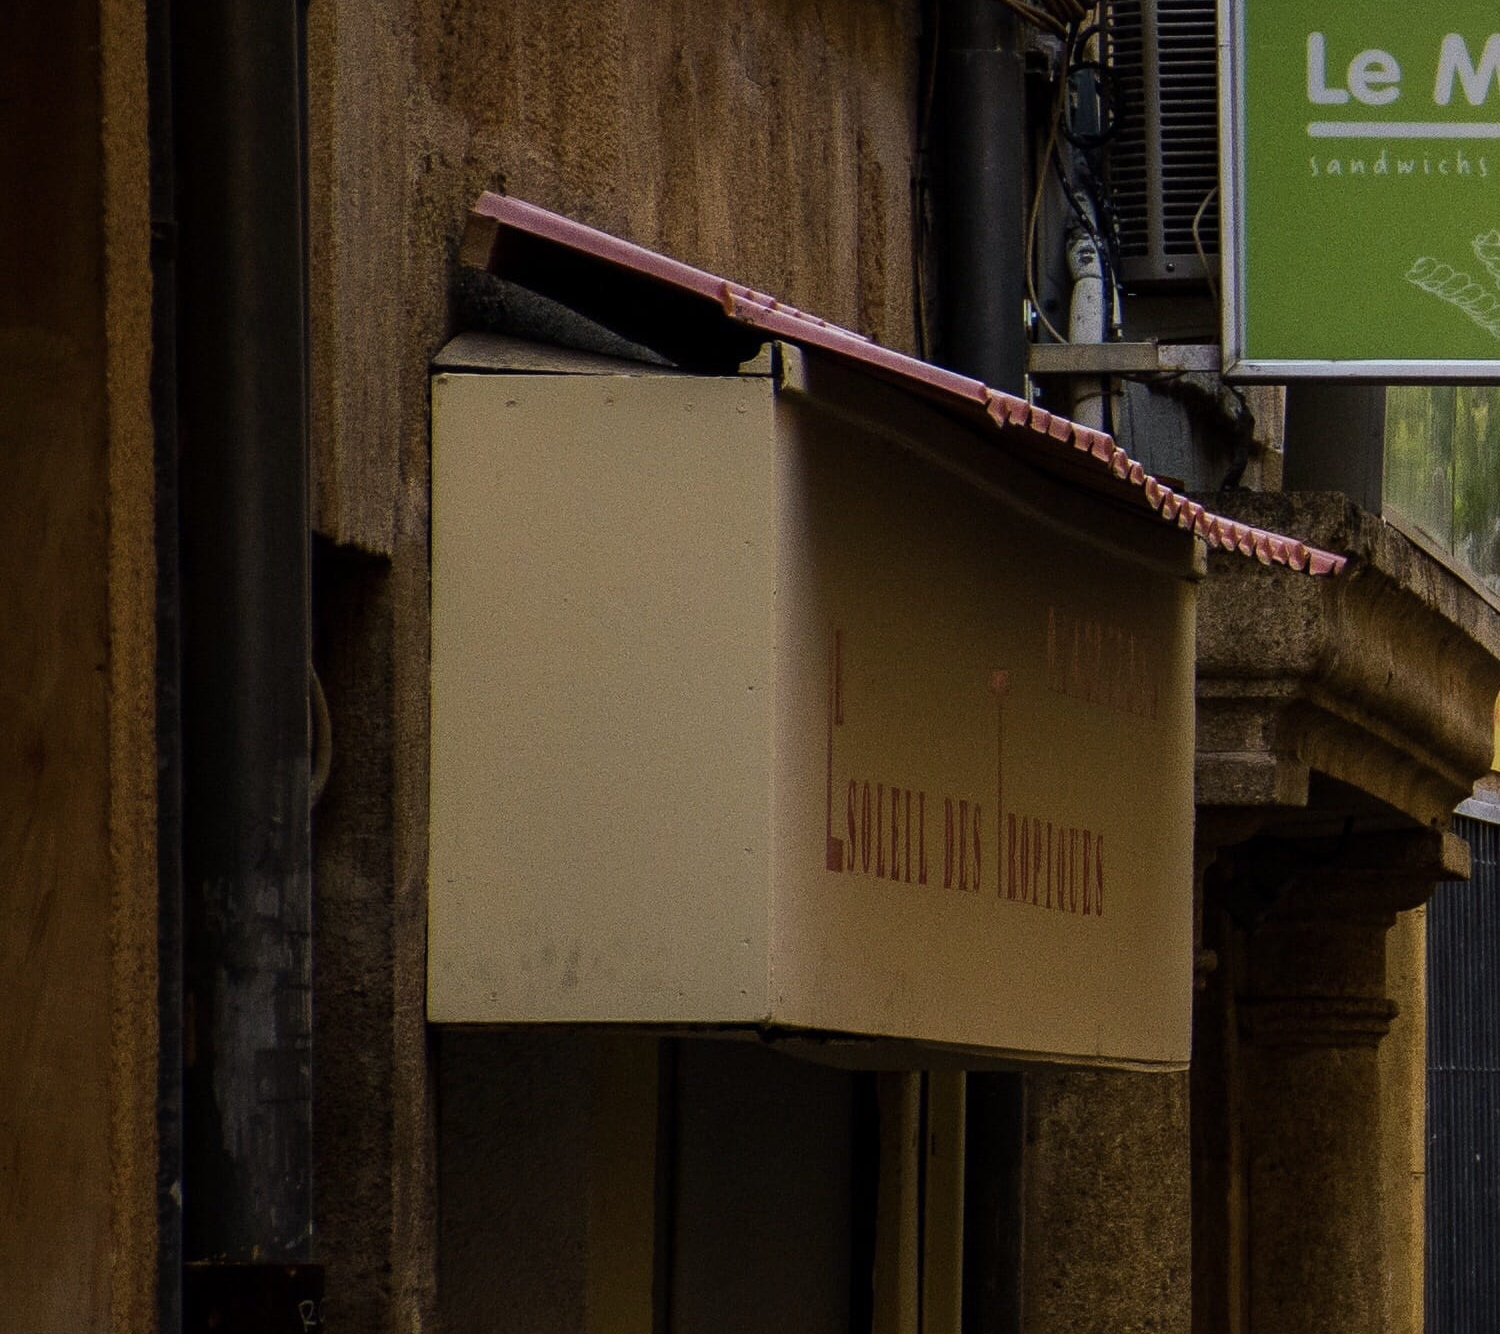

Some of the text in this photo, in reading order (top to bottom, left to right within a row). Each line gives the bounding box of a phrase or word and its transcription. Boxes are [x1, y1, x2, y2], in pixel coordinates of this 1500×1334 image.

[1306, 31, 1401, 106] Le
[1309, 149, 1490, 178] sandwichs
[845, 778, 928, 886] SOLEIL
[943, 784, 983, 894] DES
